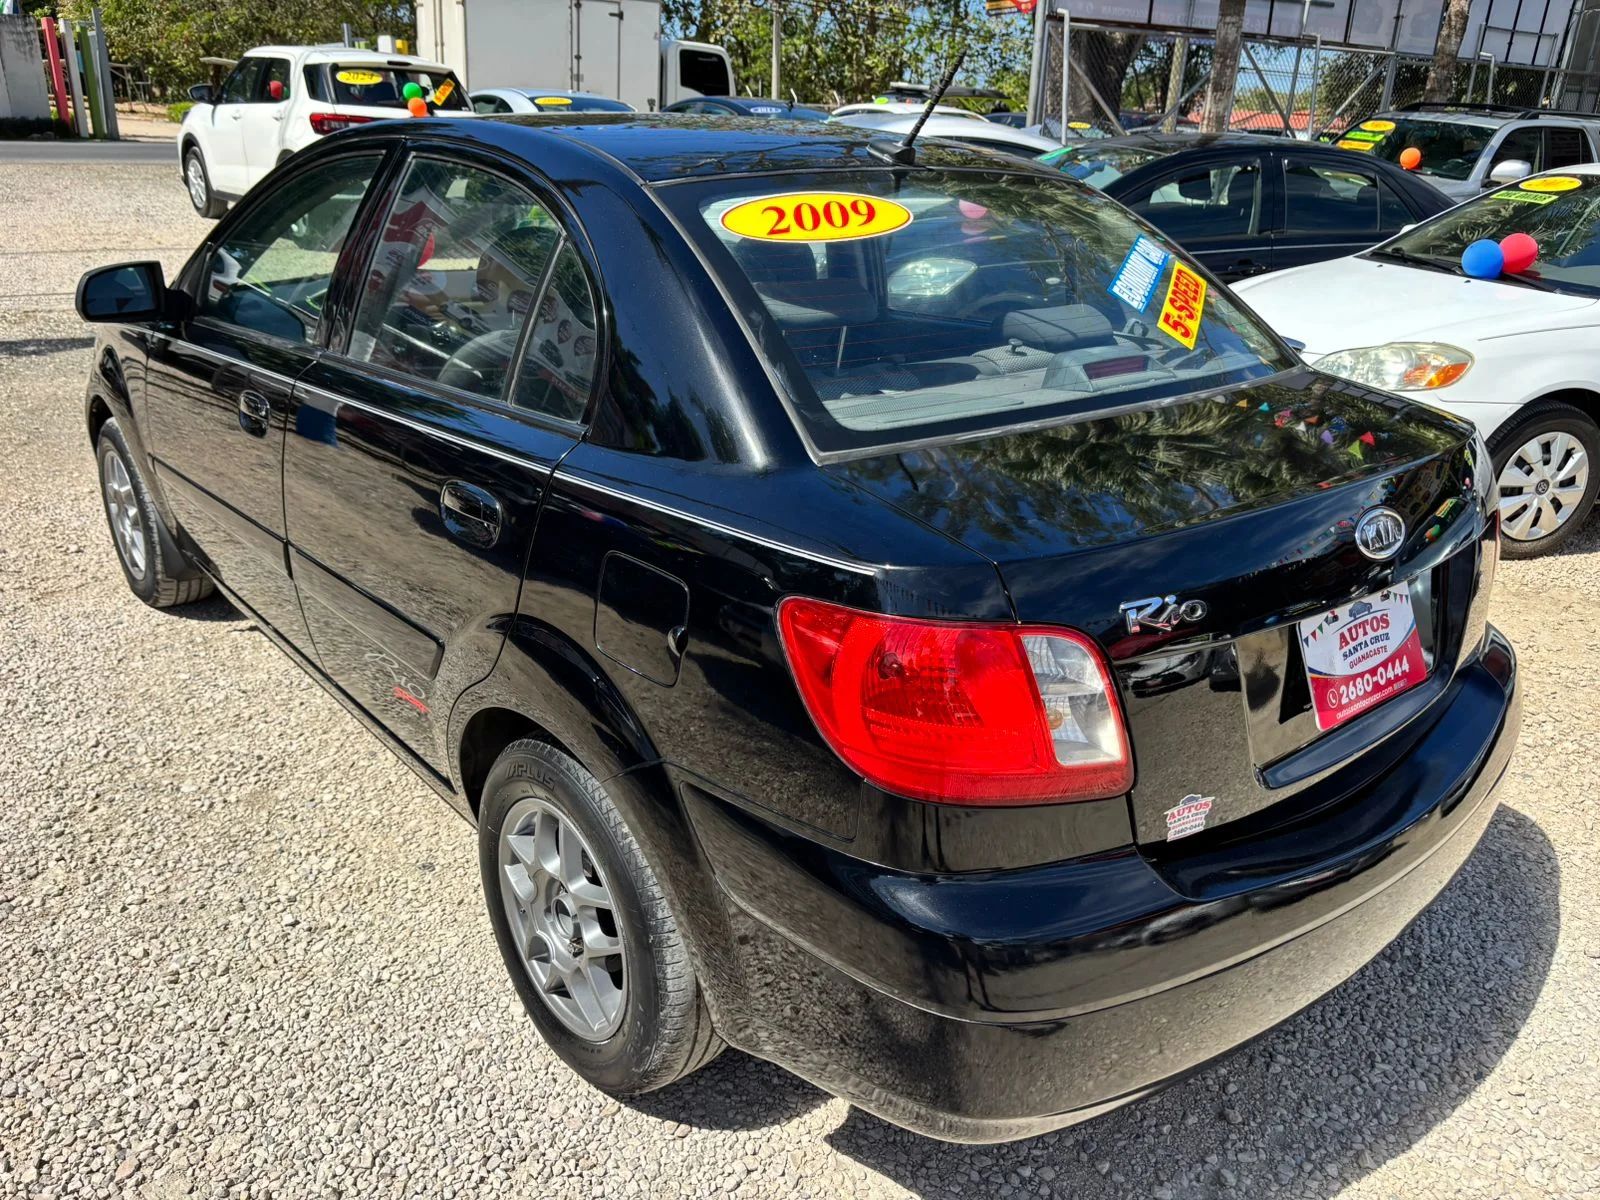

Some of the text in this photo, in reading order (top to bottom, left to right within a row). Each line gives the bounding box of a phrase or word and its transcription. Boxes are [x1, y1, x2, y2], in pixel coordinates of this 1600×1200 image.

[761, 199, 876, 236] 2009
[1112, 250, 1159, 310] ECONOMY
[1163, 268, 1202, 338] 5-SPEED
[1119, 594, 1208, 635] Rio
[1339, 612, 1390, 651] AUTOS
[1342, 632, 1391, 661] SANTA CRUZ
[1349, 645, 1388, 670] GUANACASTE
[1340, 655, 1410, 705] 2680-0444
[1168, 800, 1211, 821] AUTOS
